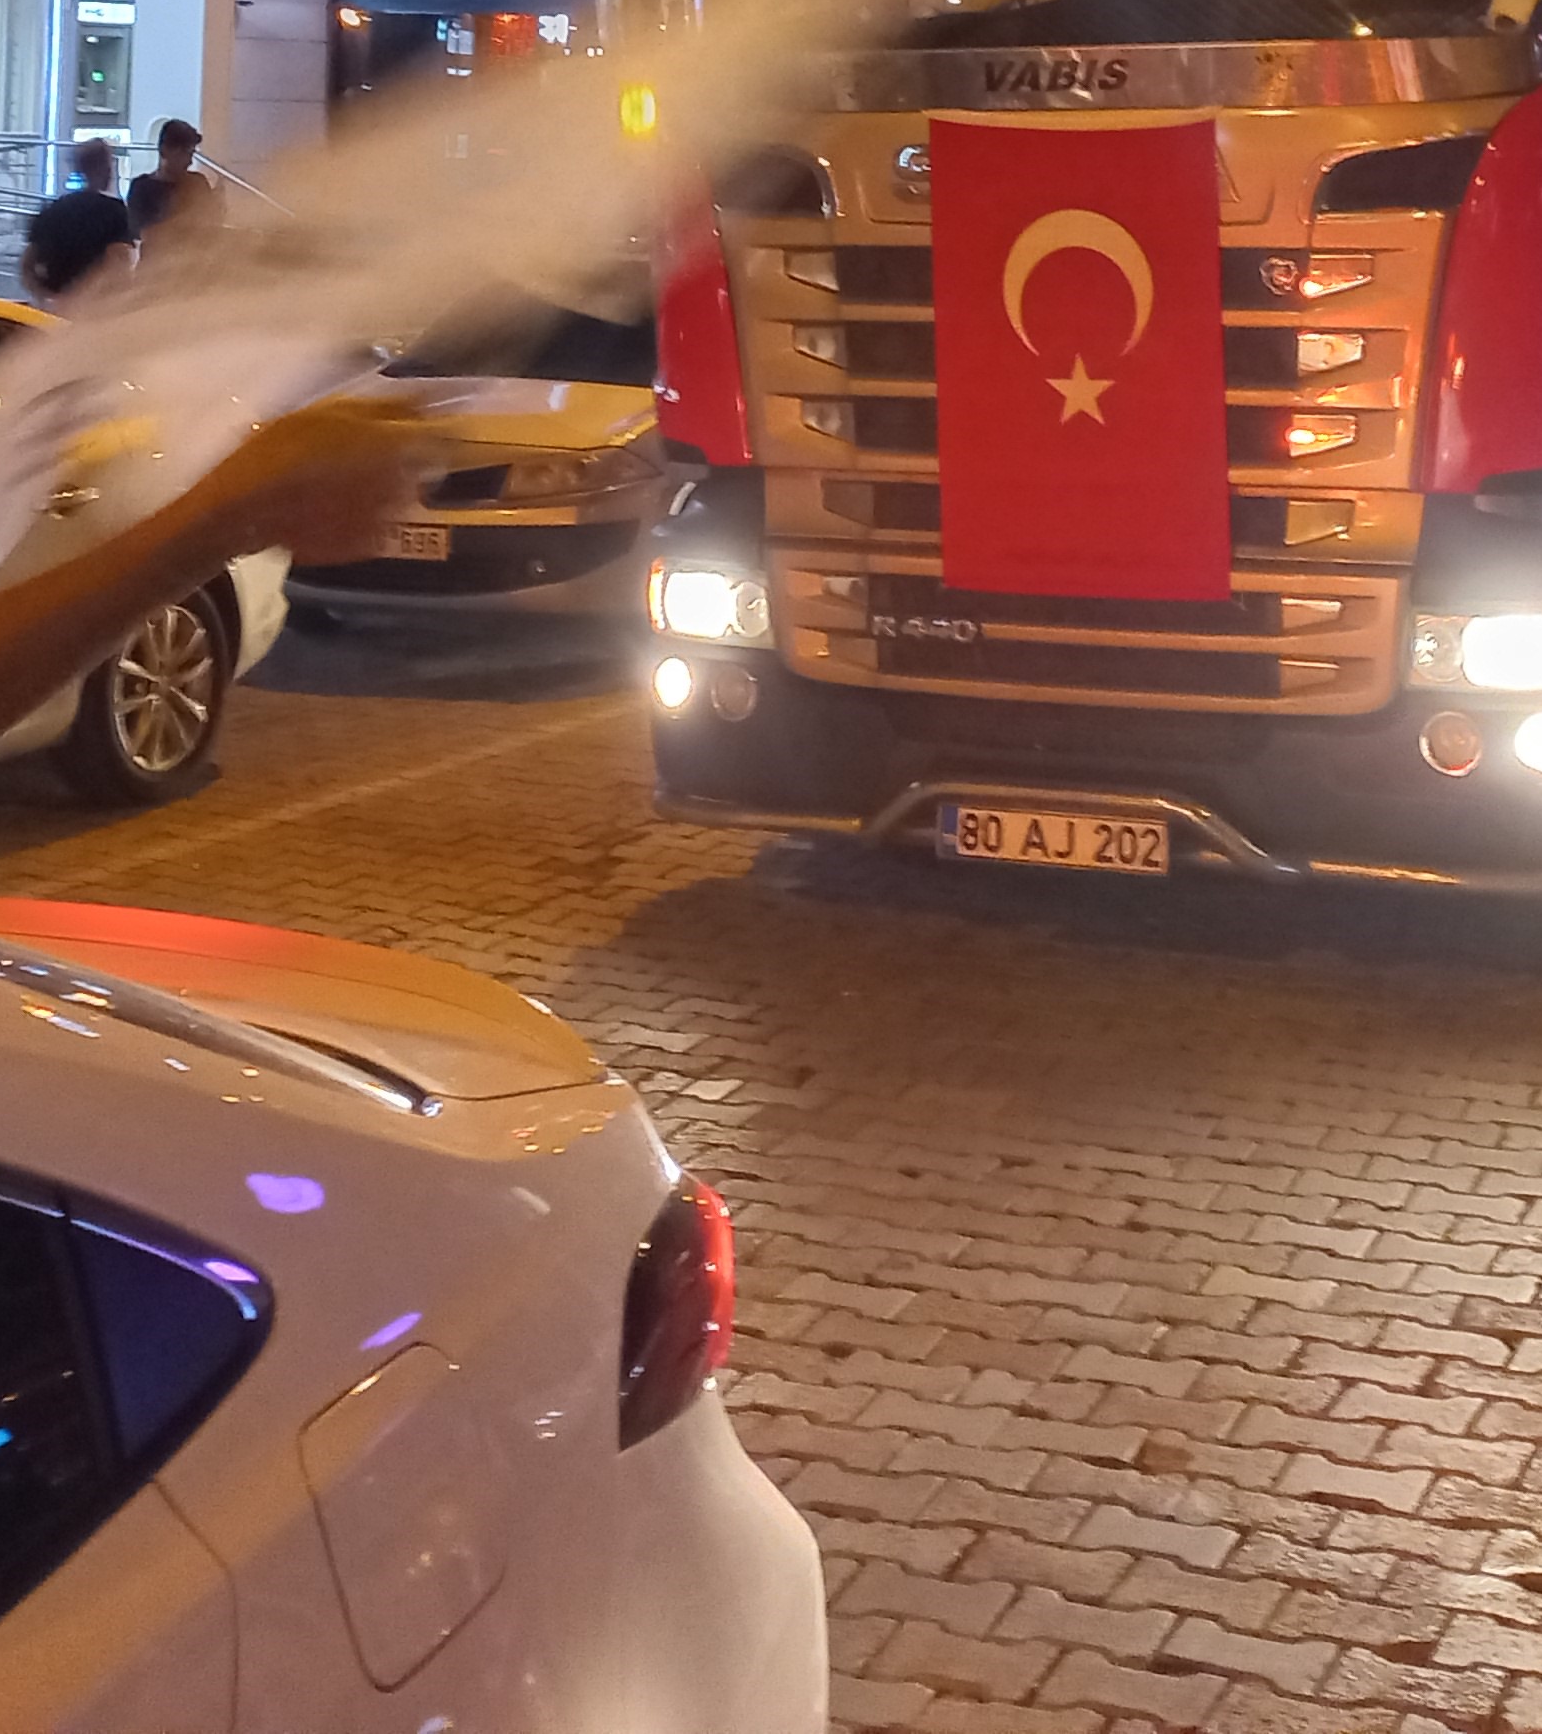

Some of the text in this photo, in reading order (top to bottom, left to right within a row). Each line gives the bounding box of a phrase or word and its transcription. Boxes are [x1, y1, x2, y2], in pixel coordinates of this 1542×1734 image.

[983, 58, 1130, 93] VABIS
[961, 813, 1161, 868] 80 AJ 202
